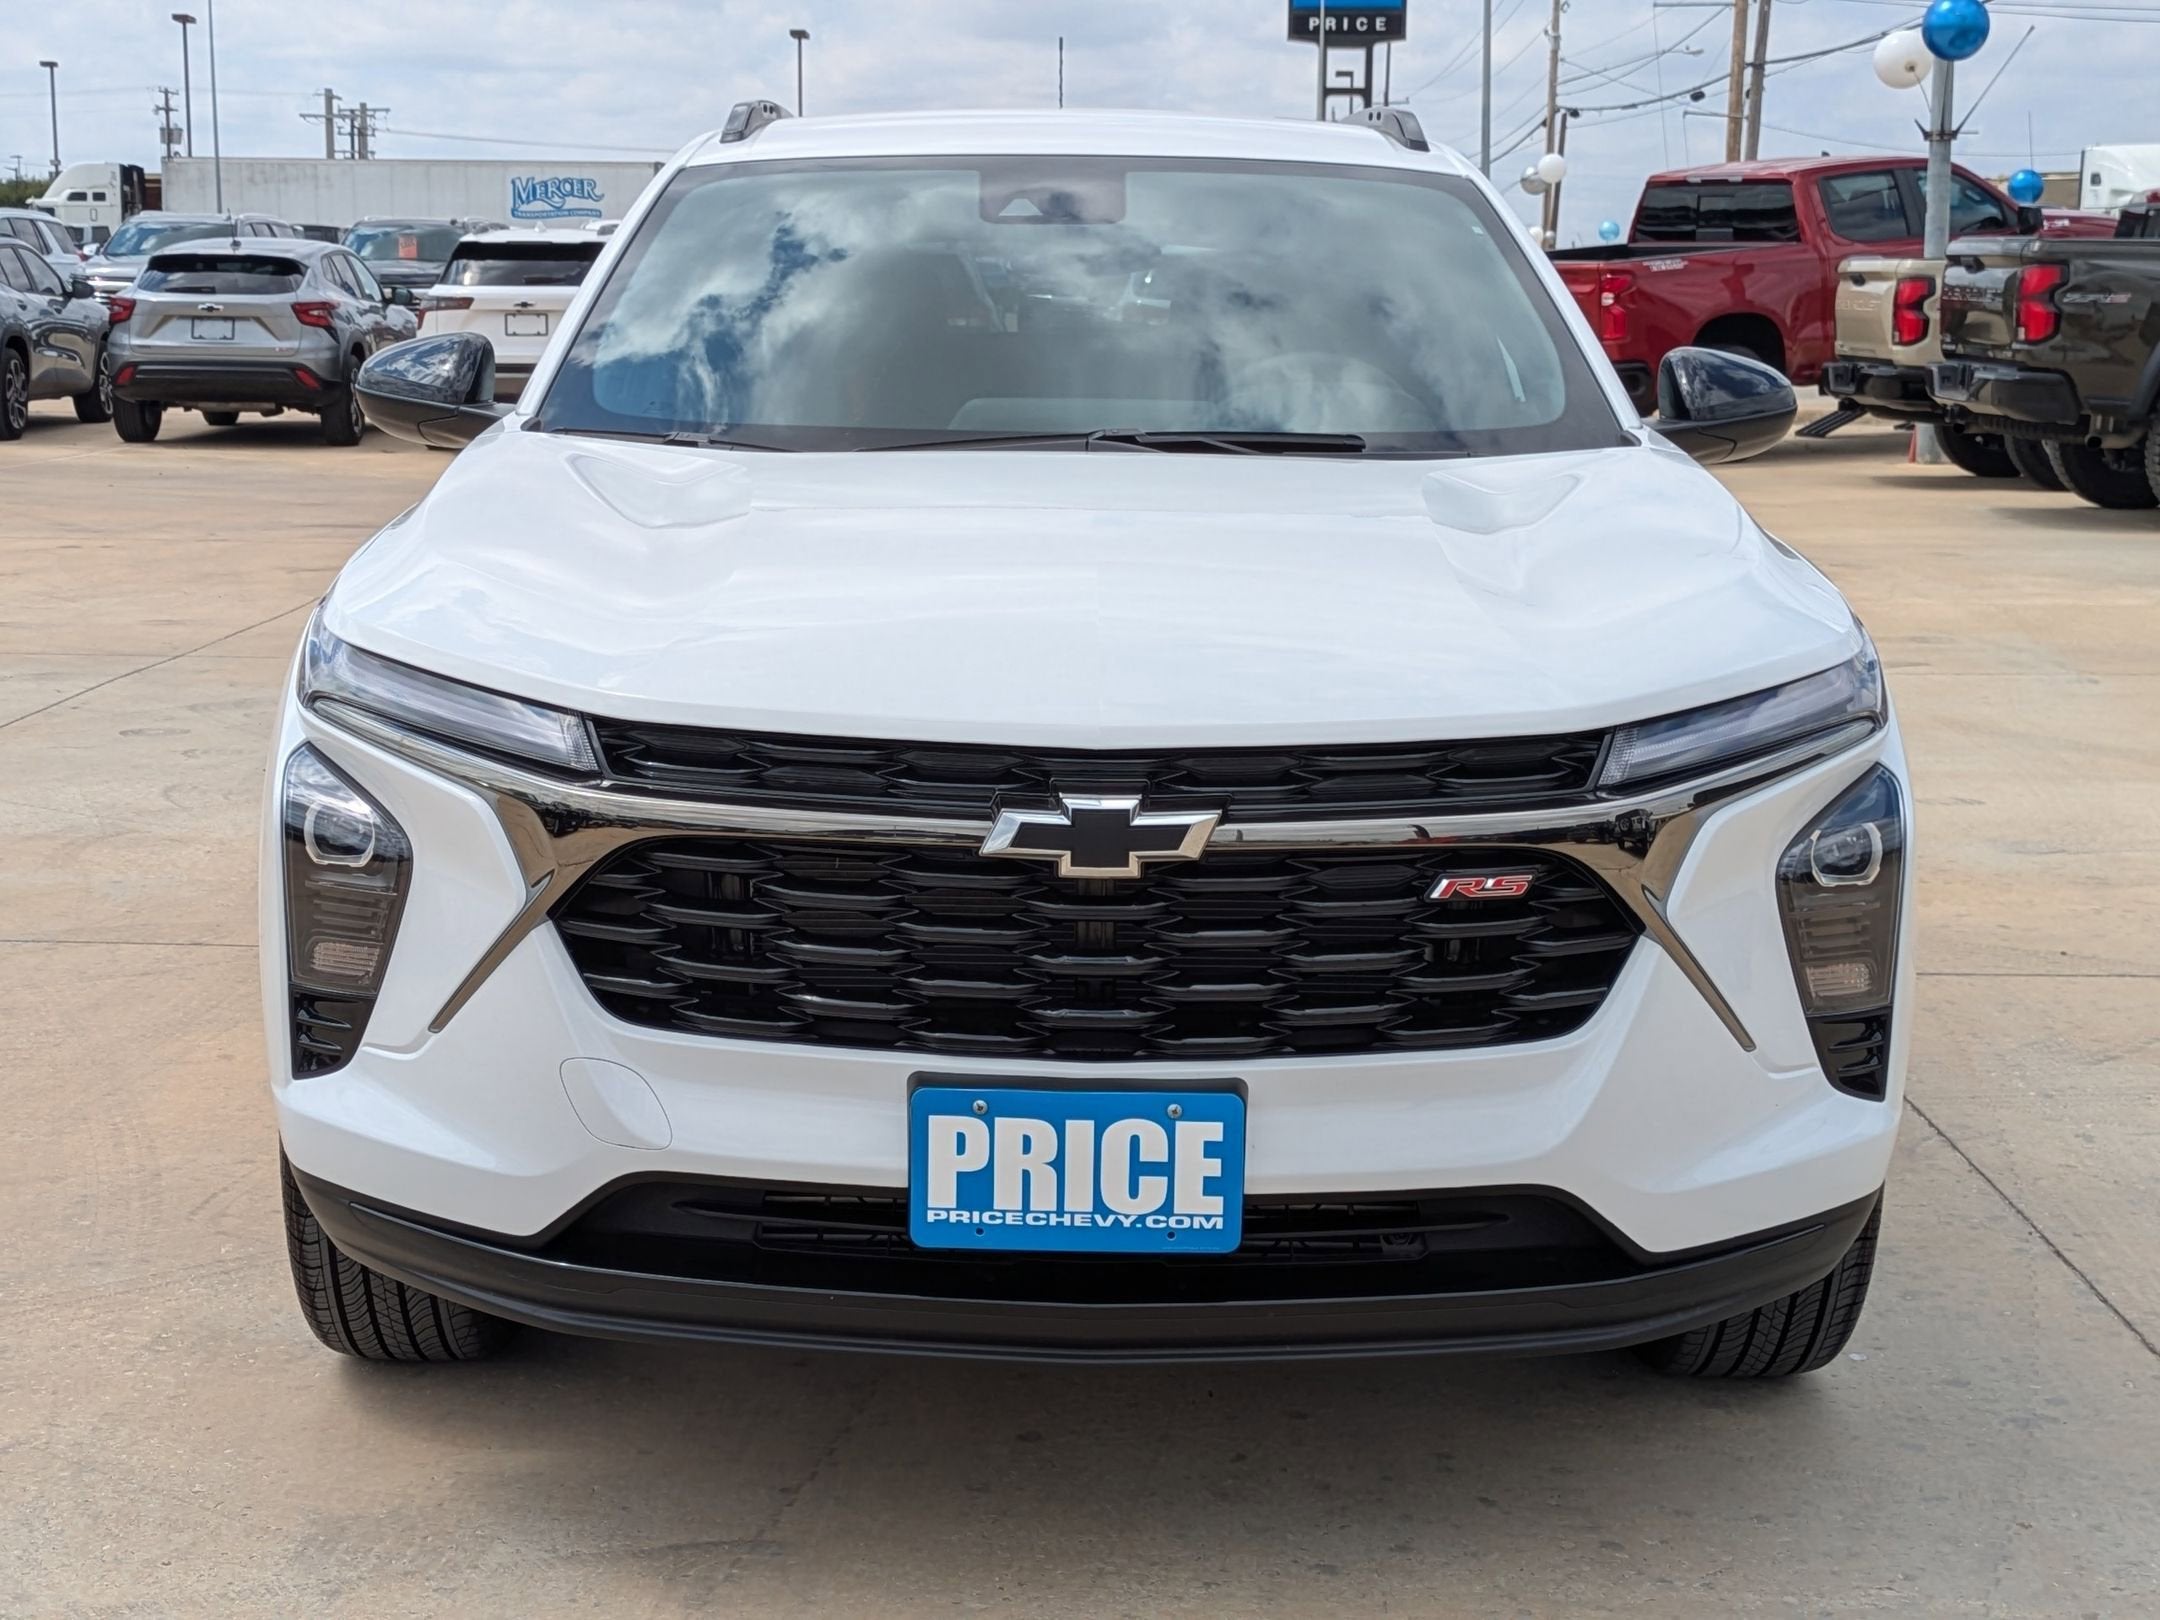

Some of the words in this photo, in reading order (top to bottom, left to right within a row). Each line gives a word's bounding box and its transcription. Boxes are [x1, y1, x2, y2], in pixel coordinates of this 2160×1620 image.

[1308, 16, 1387, 31] PRICE
[511, 177, 604, 209] MERCER
[570, 208, 601, 217] COMPANY
[1430, 875, 1532, 898] RS
[927, 1115, 1224, 1215] PRICE
[927, 1209, 1224, 1230] PRICECHEVY.COM
